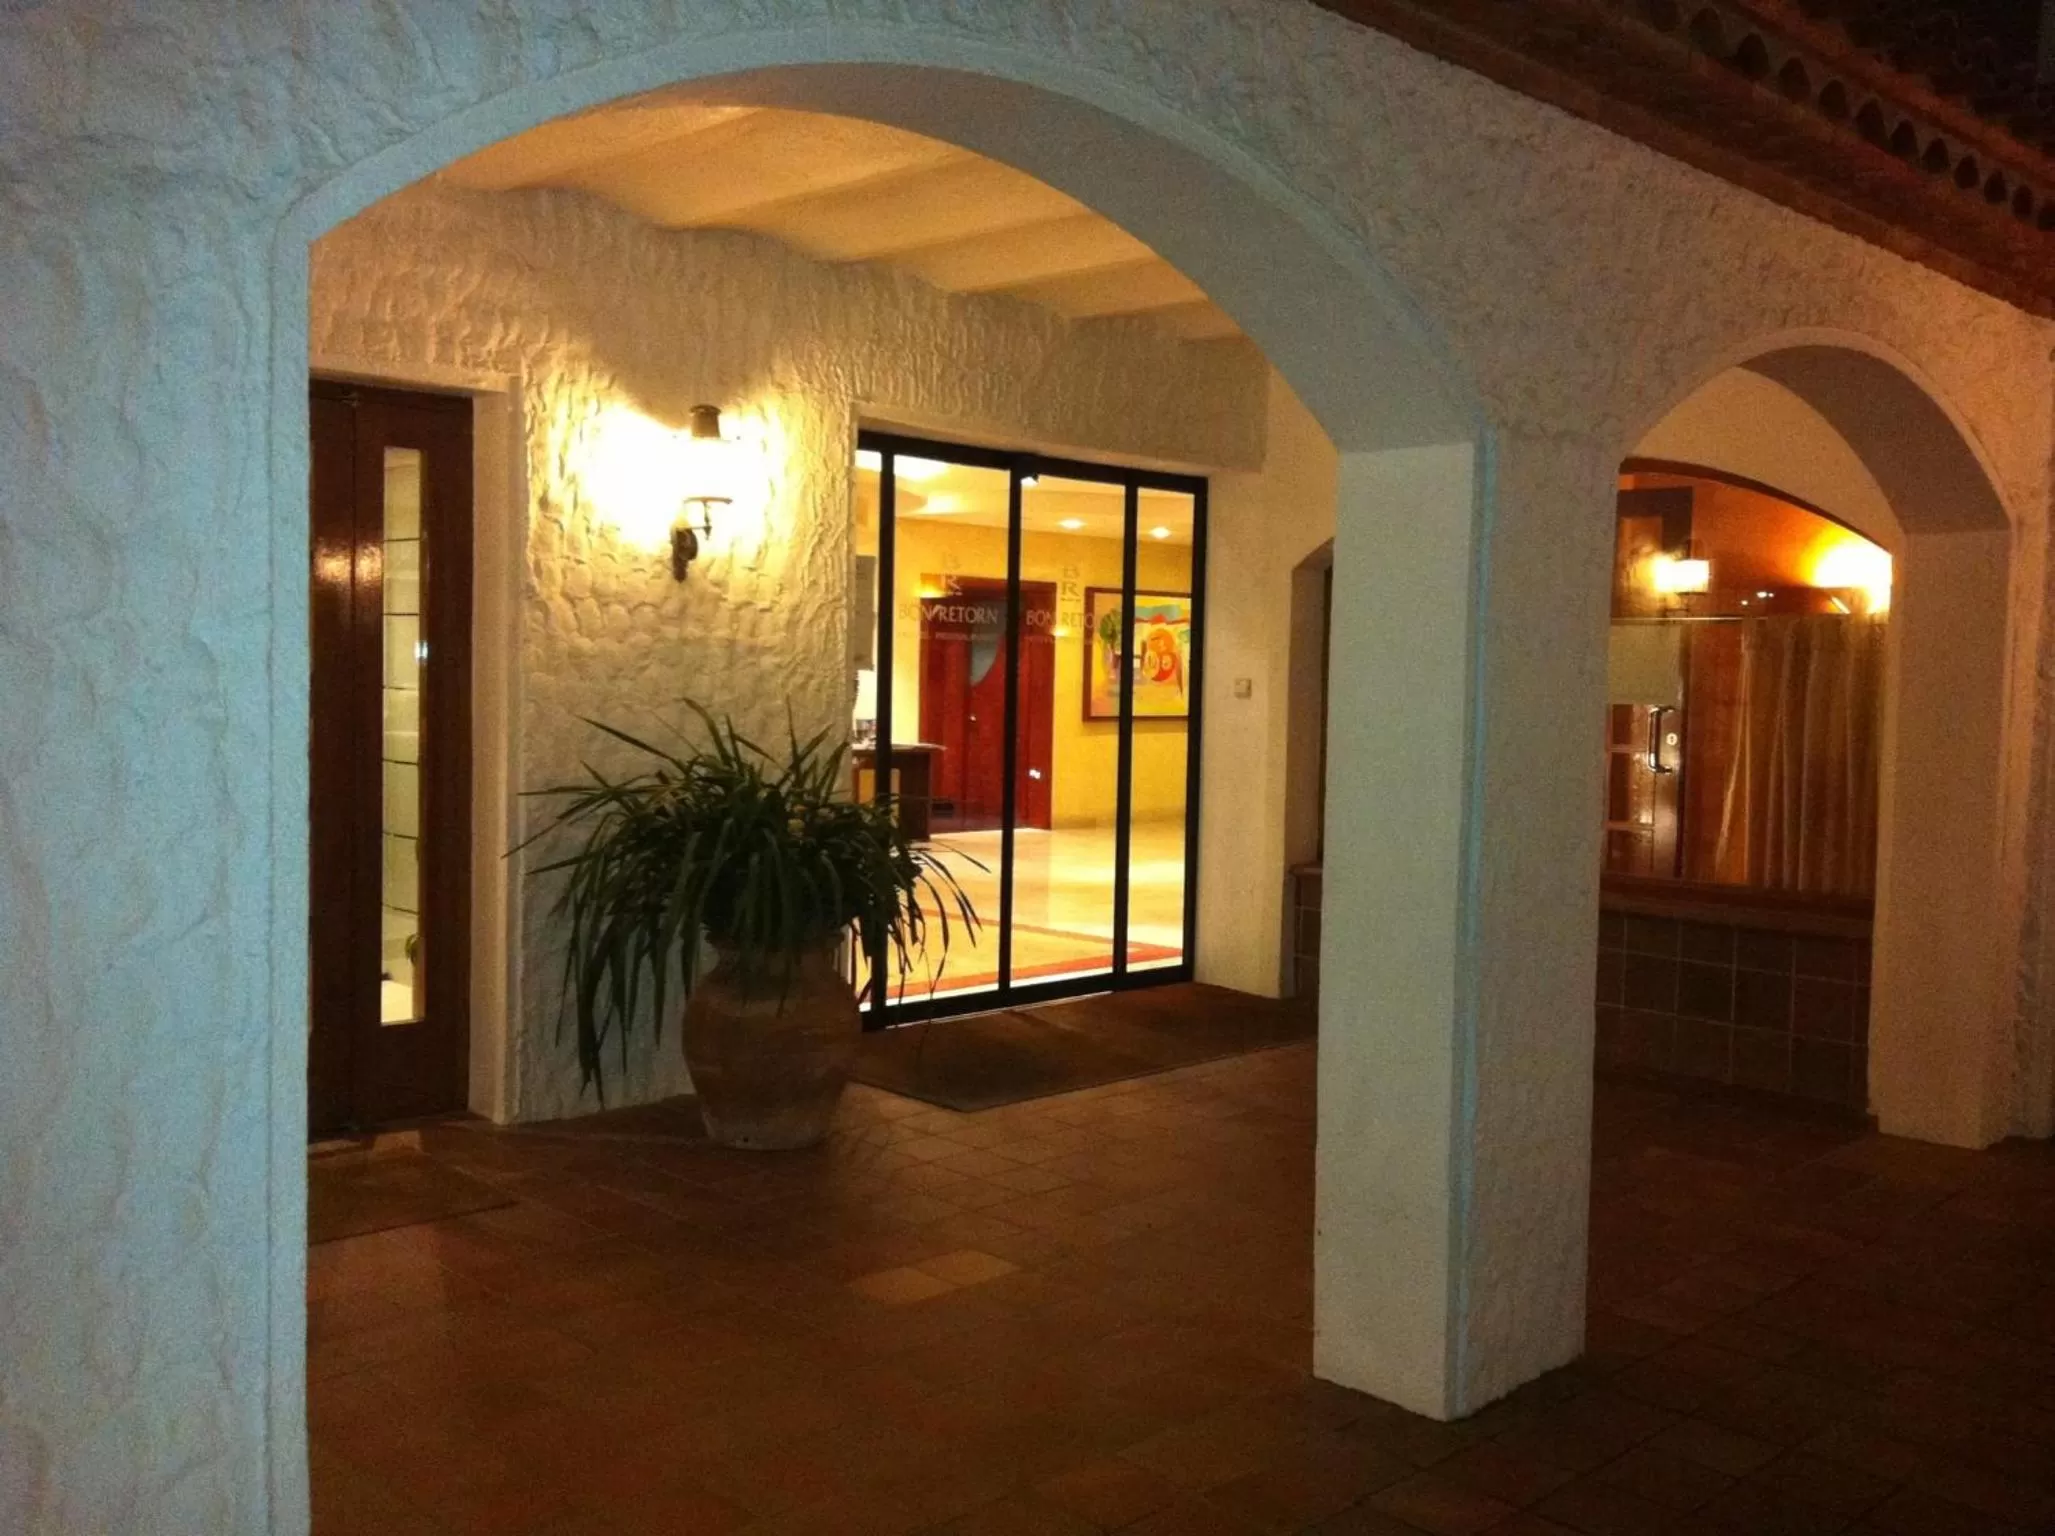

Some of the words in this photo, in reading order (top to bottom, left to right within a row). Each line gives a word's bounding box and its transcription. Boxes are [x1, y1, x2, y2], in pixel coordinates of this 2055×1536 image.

[1061, 582, 1081, 597] R
[899, 604, 933, 622] BON
[938, 604, 999, 625] RETORN
